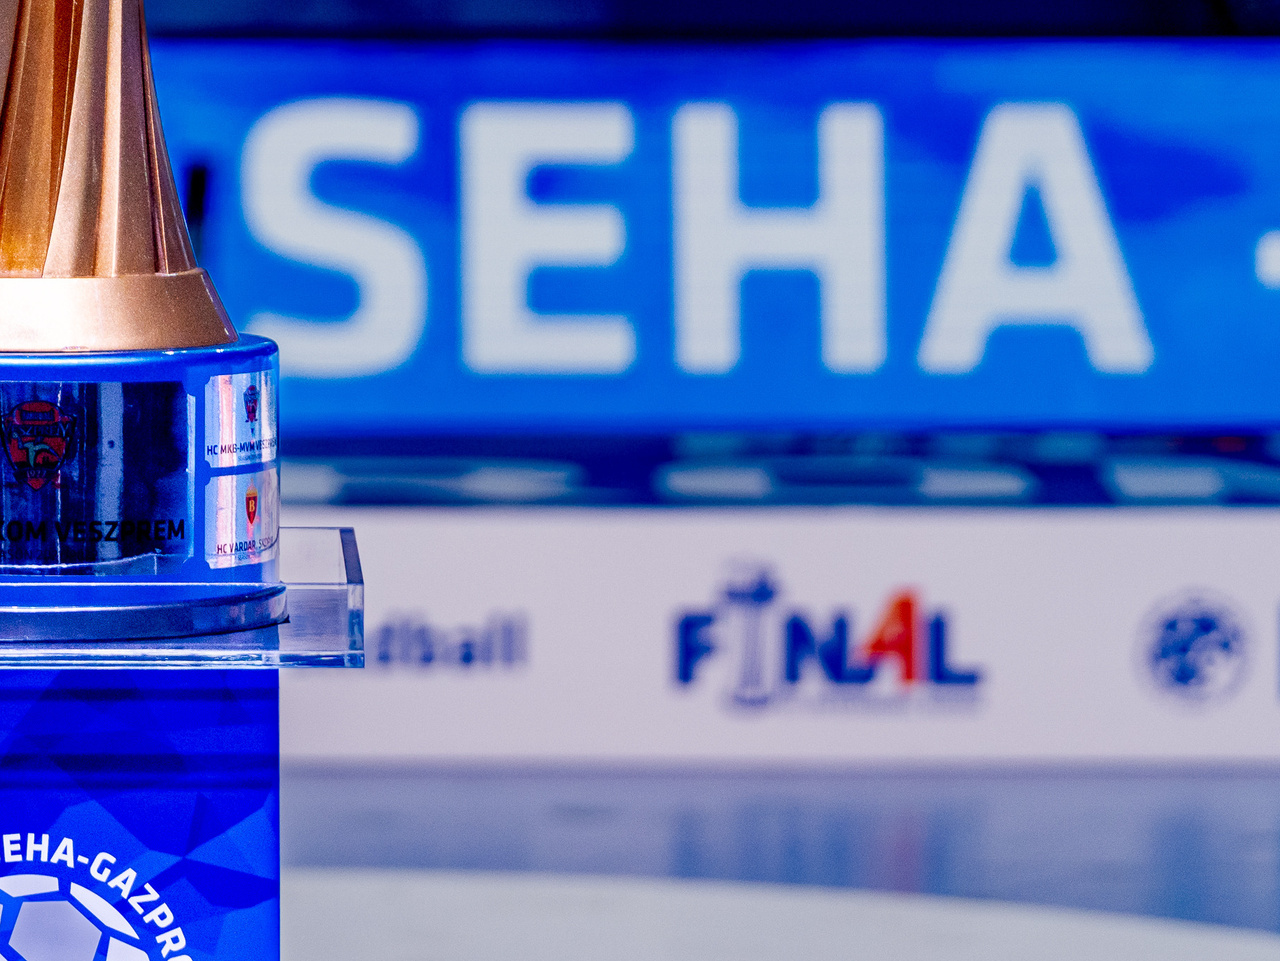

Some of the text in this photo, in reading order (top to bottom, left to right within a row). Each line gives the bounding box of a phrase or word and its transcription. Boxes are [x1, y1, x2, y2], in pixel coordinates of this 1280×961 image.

[239, 96, 1156, 379] SEHA
[207, 445, 218, 455] HC
[216, 544, 227, 554] HC
